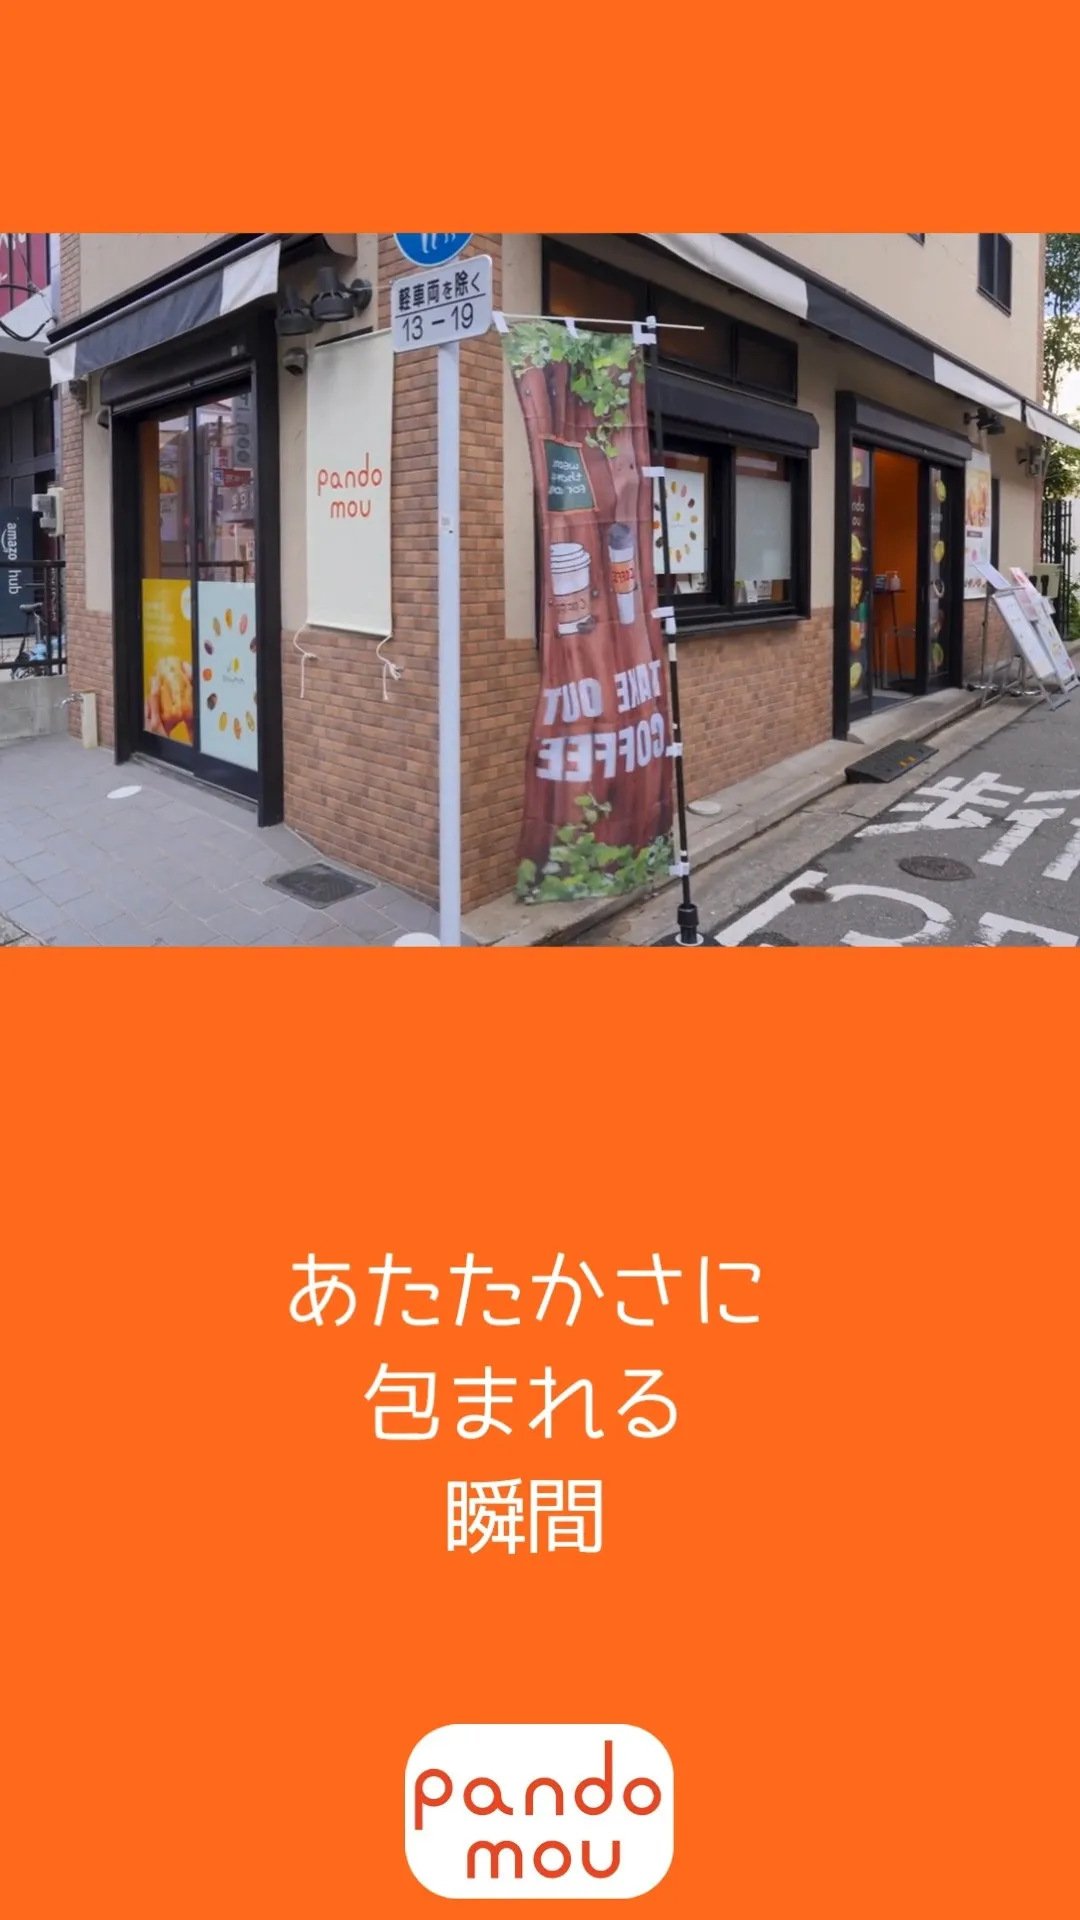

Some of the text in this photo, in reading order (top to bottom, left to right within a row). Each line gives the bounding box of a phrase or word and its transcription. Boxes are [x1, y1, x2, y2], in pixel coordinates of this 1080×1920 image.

[398, 270, 480, 311] 軽車両を除く
[317, 452, 383, 496] pando
[330, 499, 371, 519] mou
[7, 522, 22, 595] amazo hub
